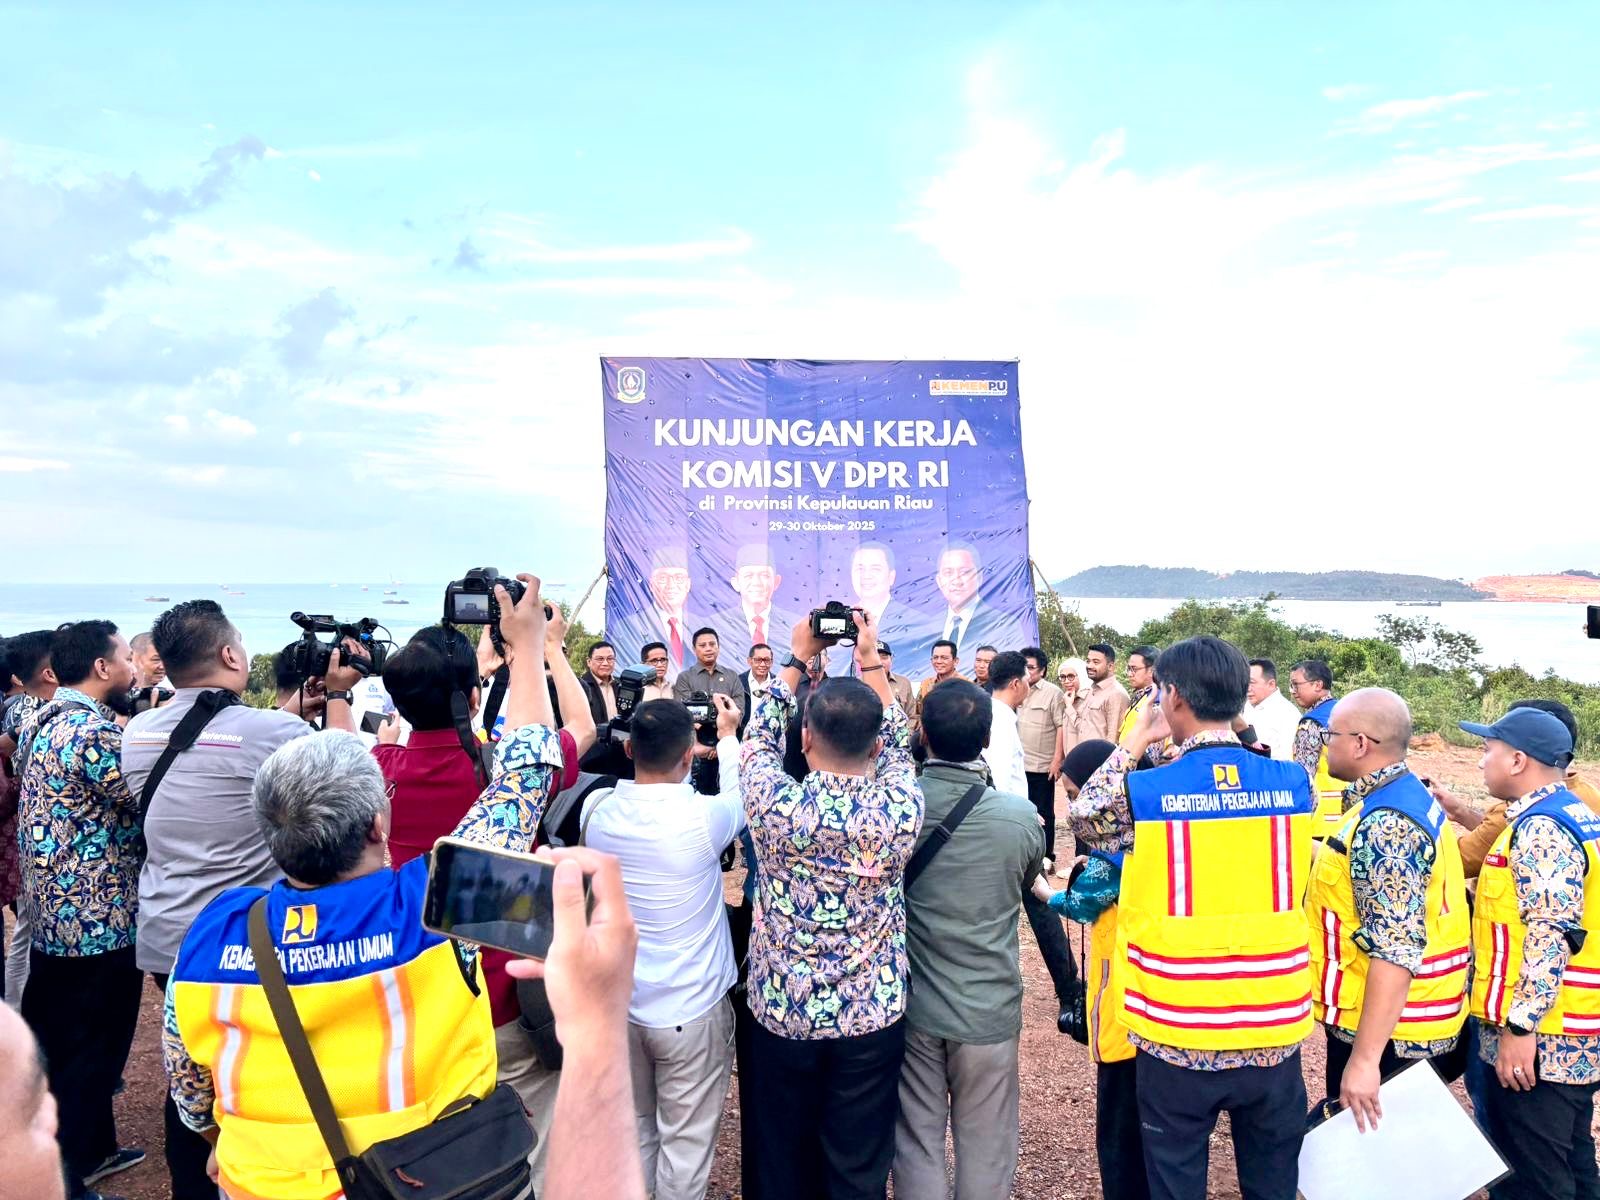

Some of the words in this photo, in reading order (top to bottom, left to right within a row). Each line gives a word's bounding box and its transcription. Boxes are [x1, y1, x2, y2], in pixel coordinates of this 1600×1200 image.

[941, 381, 1006, 391] KEMENPU
[654, 418, 865, 447] KUNJUNGAN
[873, 419, 977, 447] KERJA
[682, 460, 802, 489] KOMISI
[809, 461, 837, 488] V
[844, 461, 911, 488] DPR
[918, 460, 949, 488] RI
[698, 495, 715, 511] di
[724, 495, 793, 511] Provinsi
[797, 494, 890, 514] Kepulauan
[894, 494, 933, 510] Riau
[769, 521, 801, 531] 29-30
[802, 521, 845, 531] Oktober
[847, 521, 876, 531] 2025
[1161, 793, 1221, 812] KEMENTERIAN
[1221, 791, 1272, 811] PEKERJAAN
[1271, 790, 1294, 808] UMUM
[288, 940, 356, 974] PEKERJAAN
[357, 931, 394, 964] UMUM
